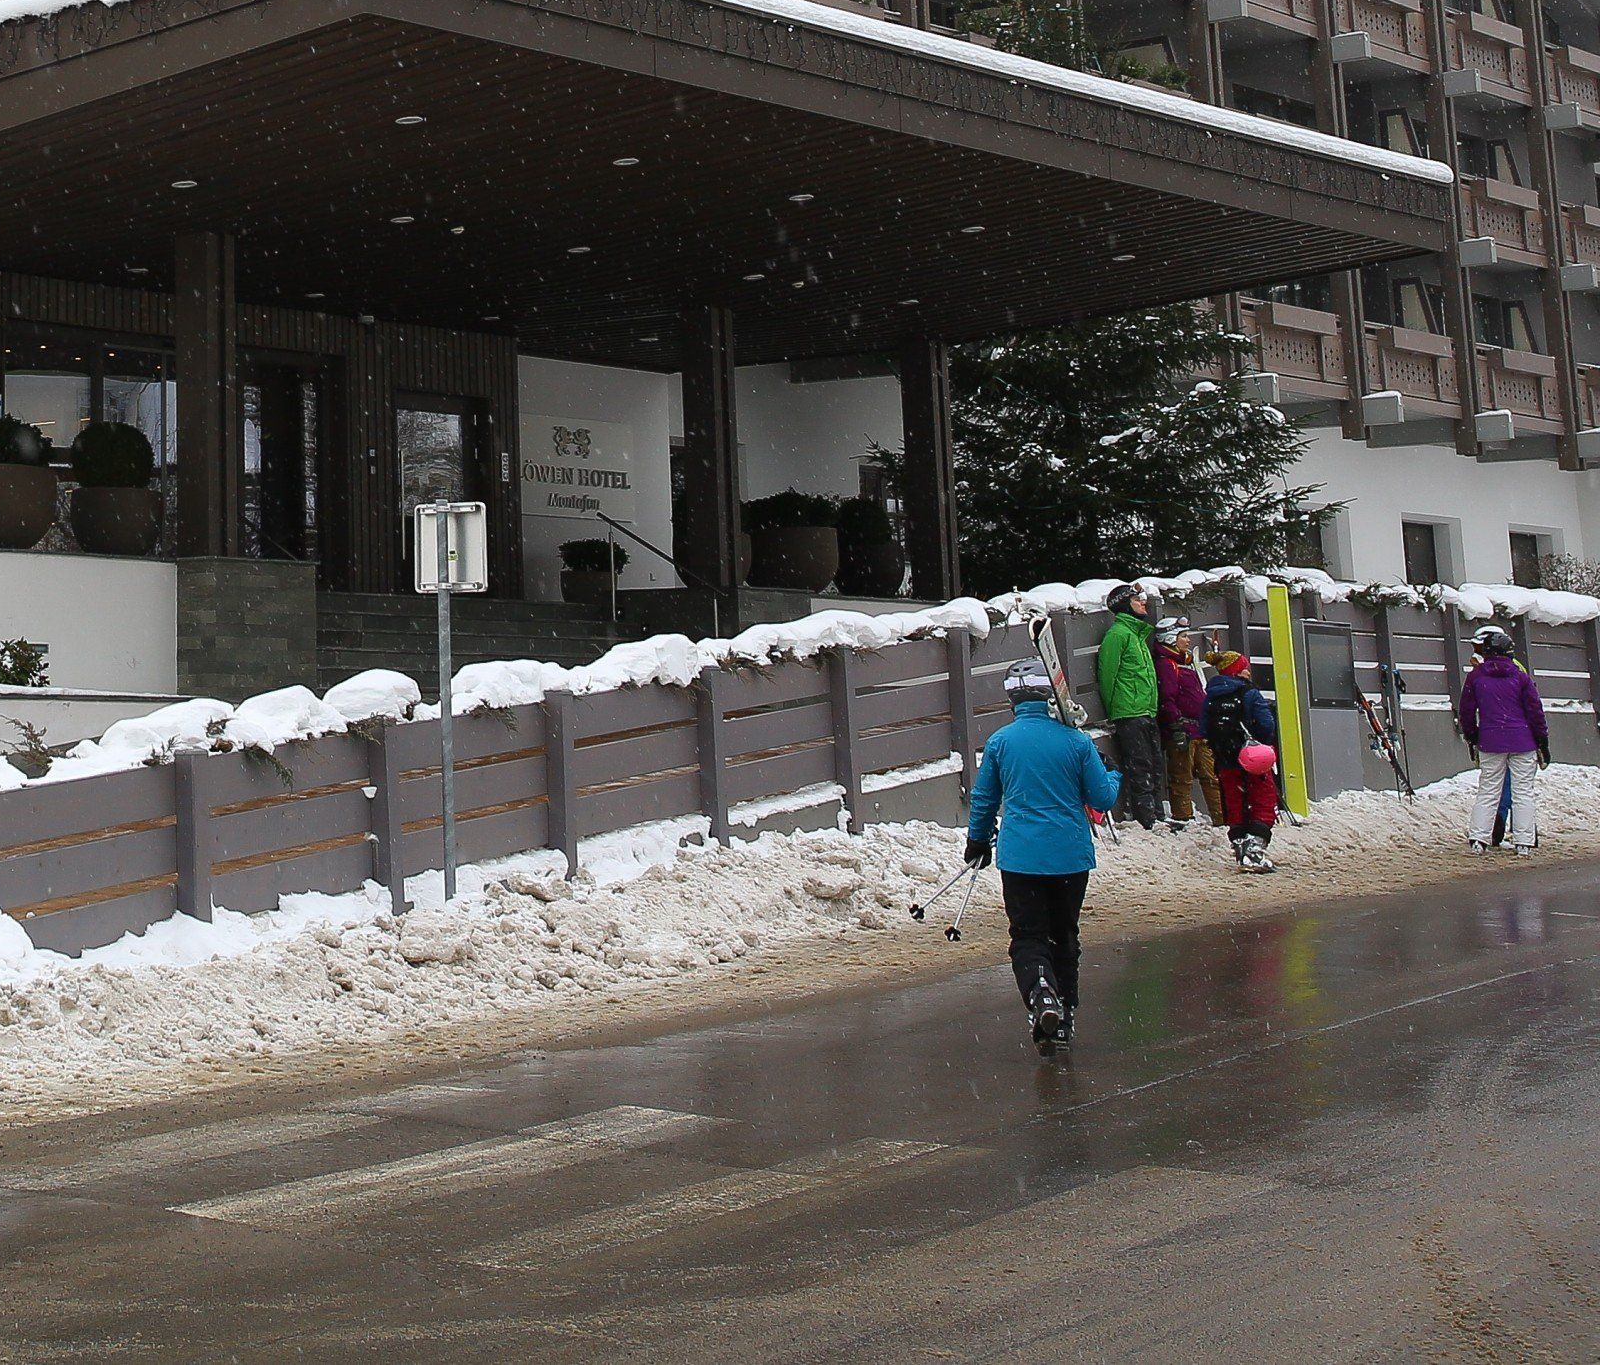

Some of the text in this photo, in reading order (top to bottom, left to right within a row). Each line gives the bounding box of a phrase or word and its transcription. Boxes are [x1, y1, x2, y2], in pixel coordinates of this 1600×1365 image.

[521, 459, 631, 490] ÖWEN HOTEL
[547, 492, 601, 513] Montafon
